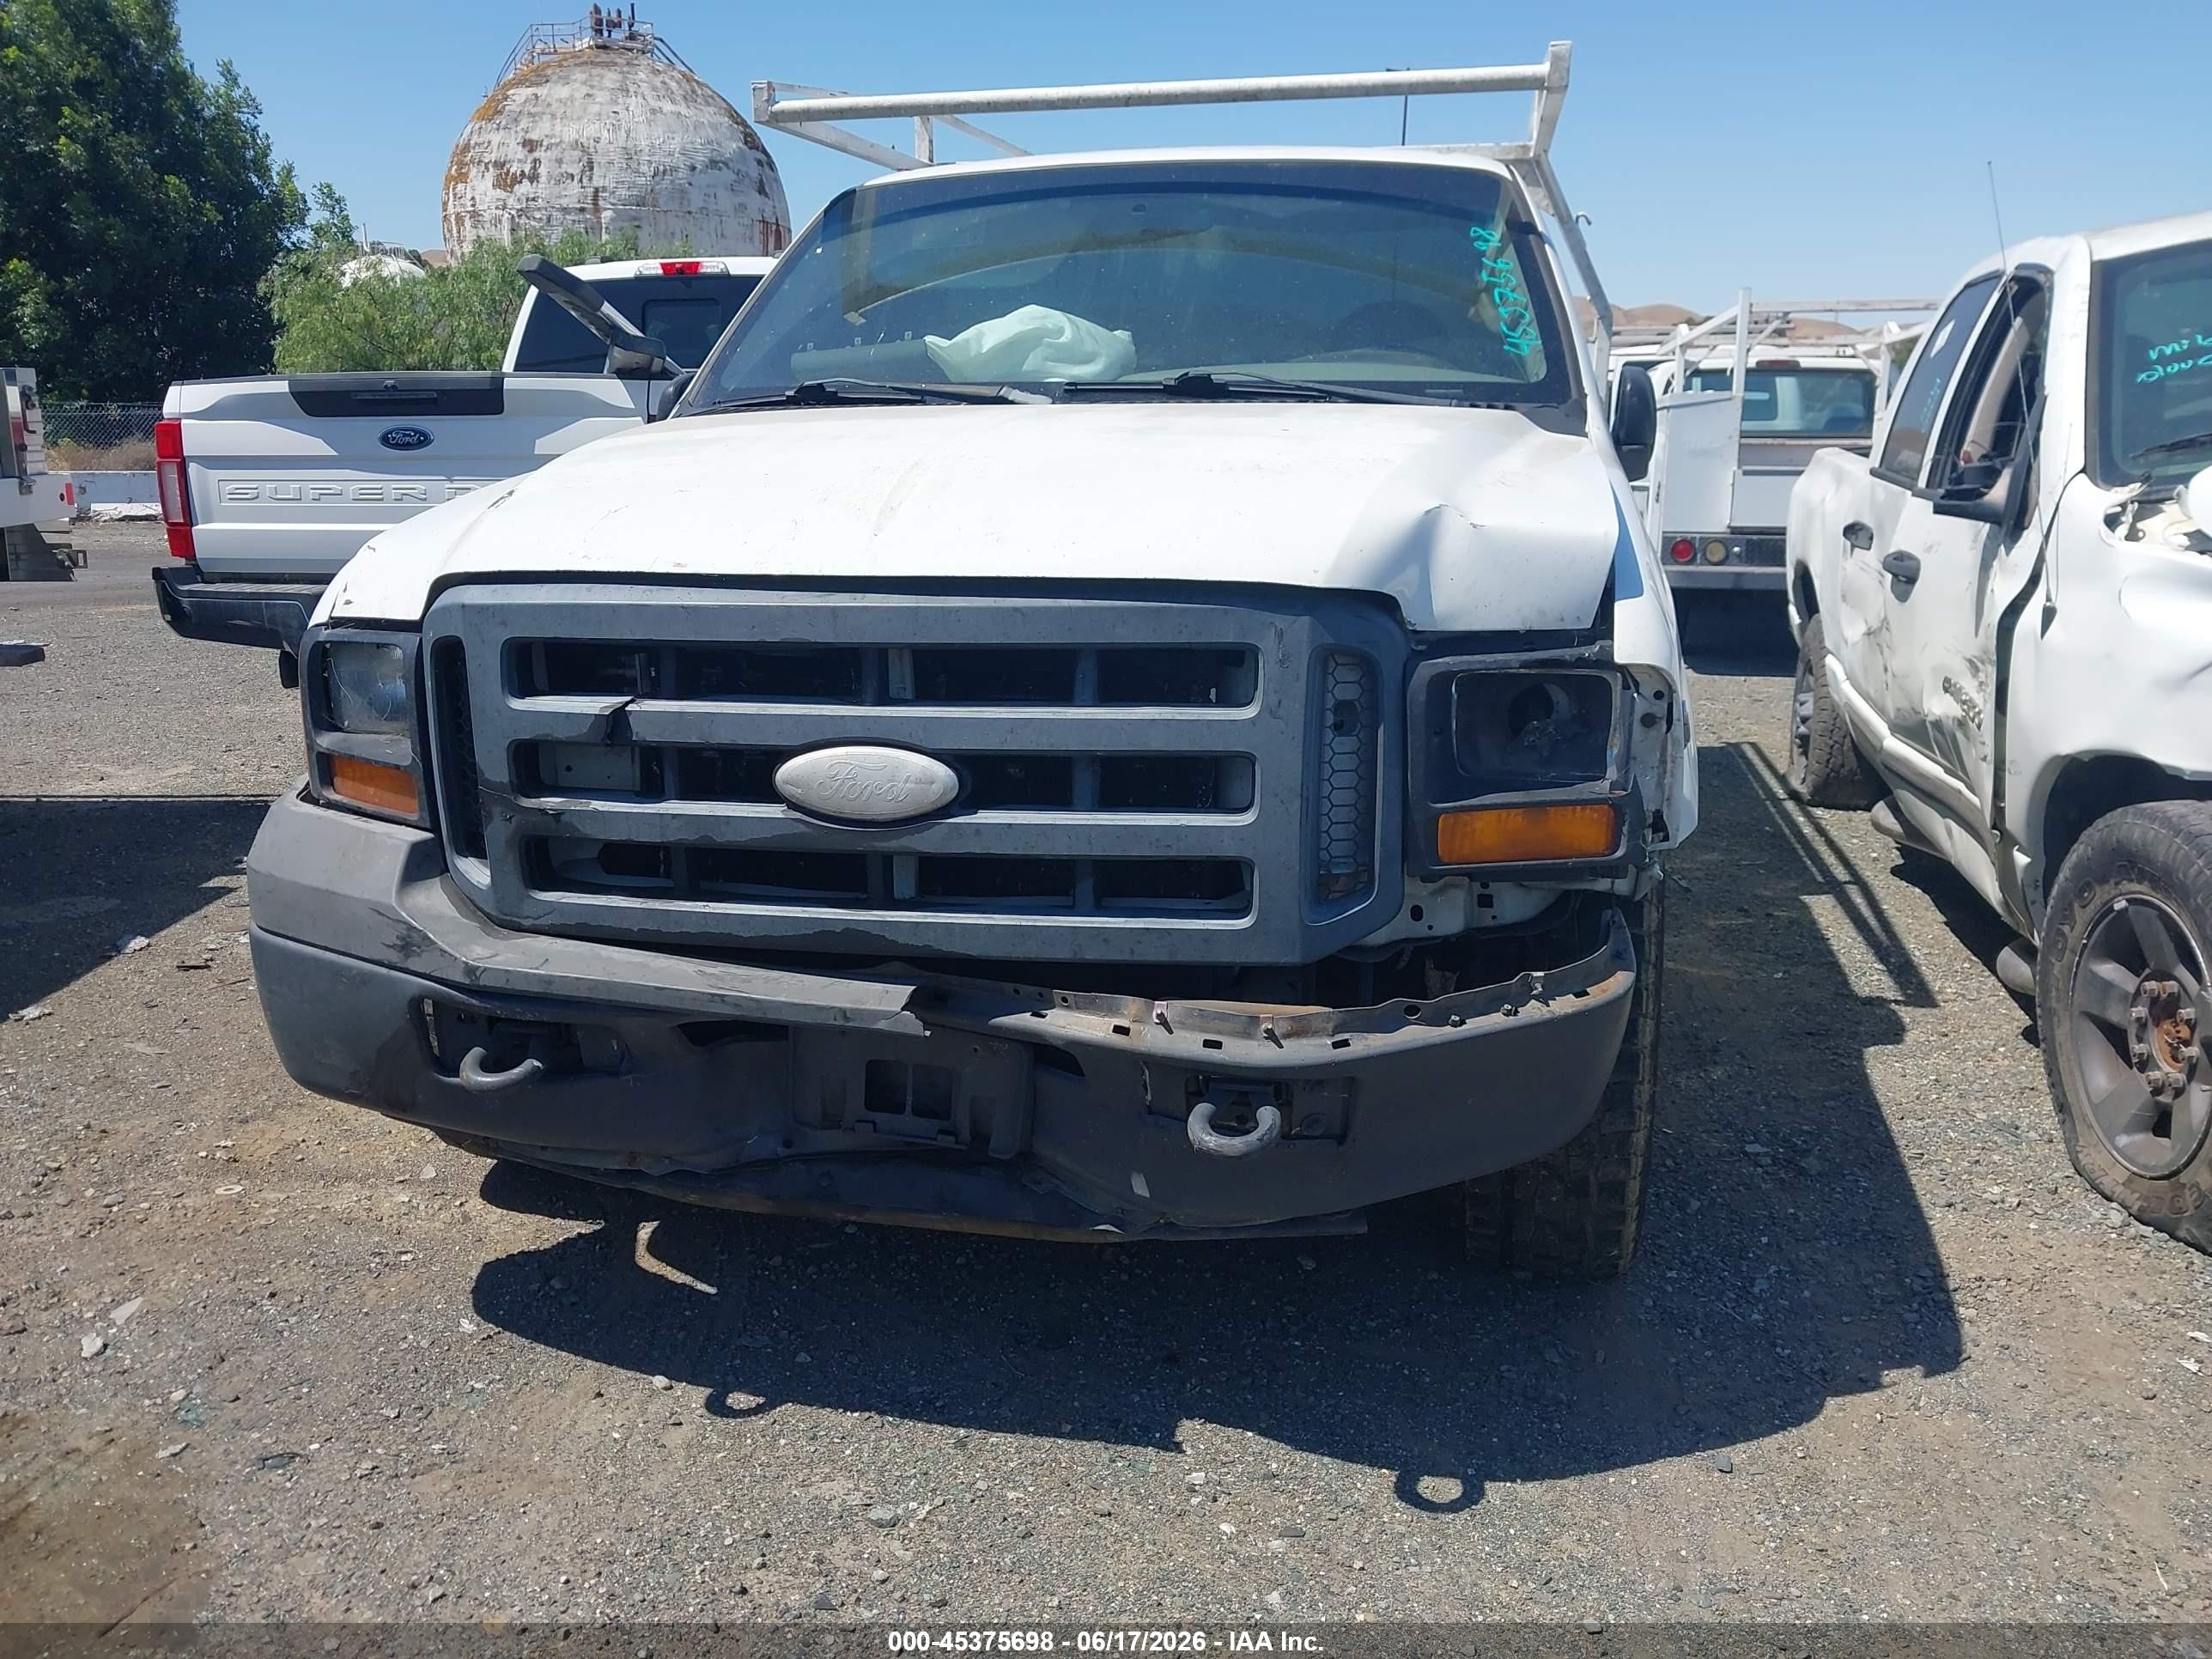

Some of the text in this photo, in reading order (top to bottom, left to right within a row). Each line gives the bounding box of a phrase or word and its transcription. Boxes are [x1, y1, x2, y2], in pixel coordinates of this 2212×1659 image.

[388, 429, 421, 445] Ford
[225, 483, 428, 502] SUPER
[814, 758, 912, 804] Ford
